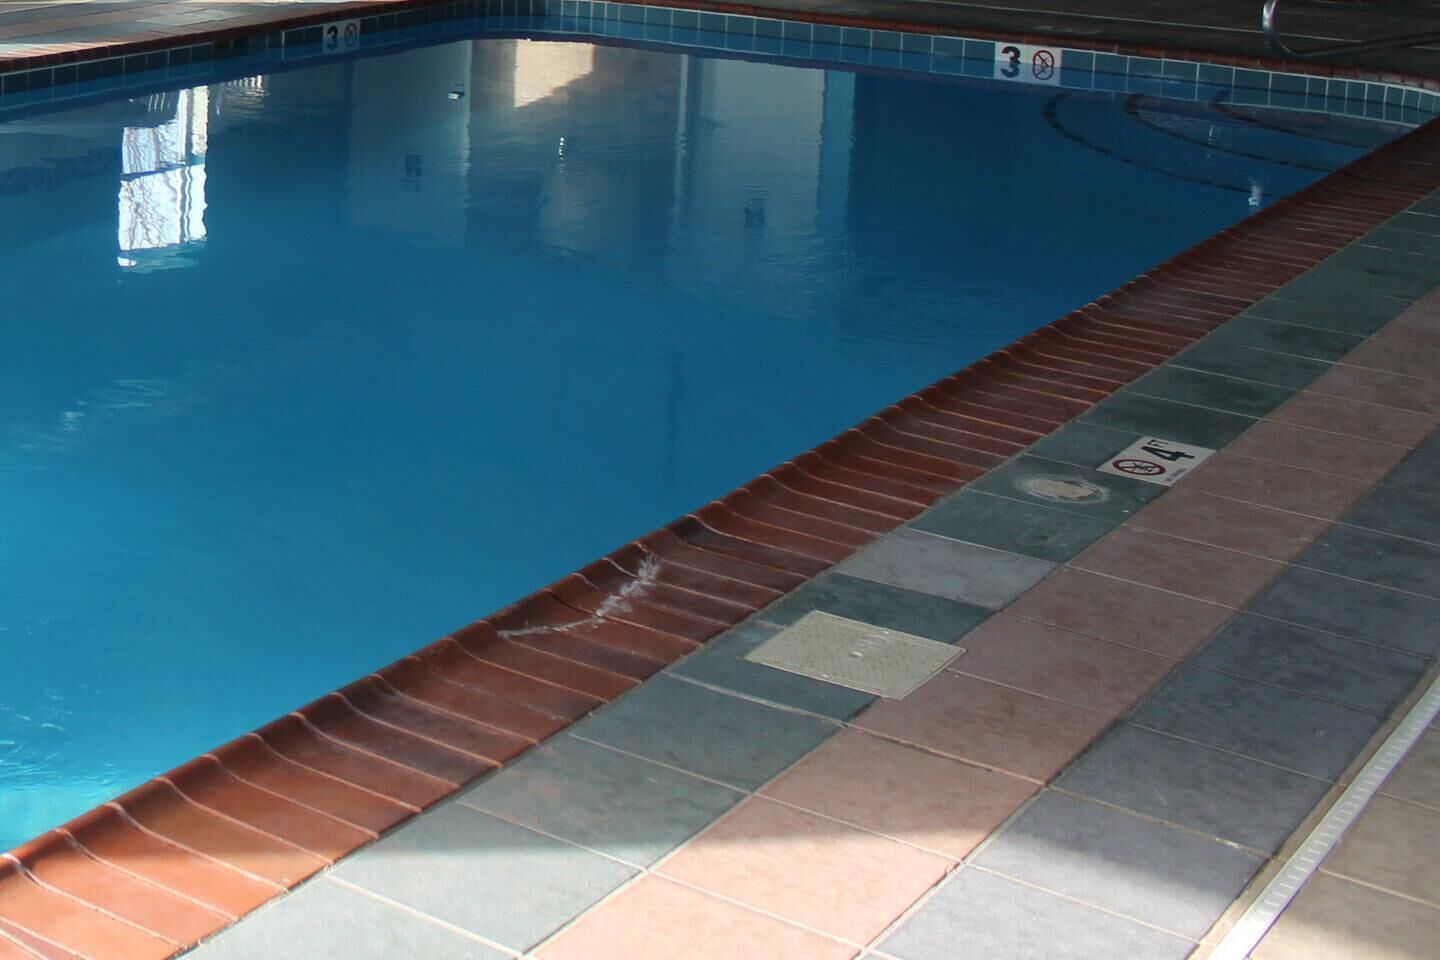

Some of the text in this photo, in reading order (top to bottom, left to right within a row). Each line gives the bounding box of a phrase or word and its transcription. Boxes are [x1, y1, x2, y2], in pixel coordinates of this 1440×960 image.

[1001, 46, 1021, 78] 3
[1141, 439, 1195, 461] 4 FT
